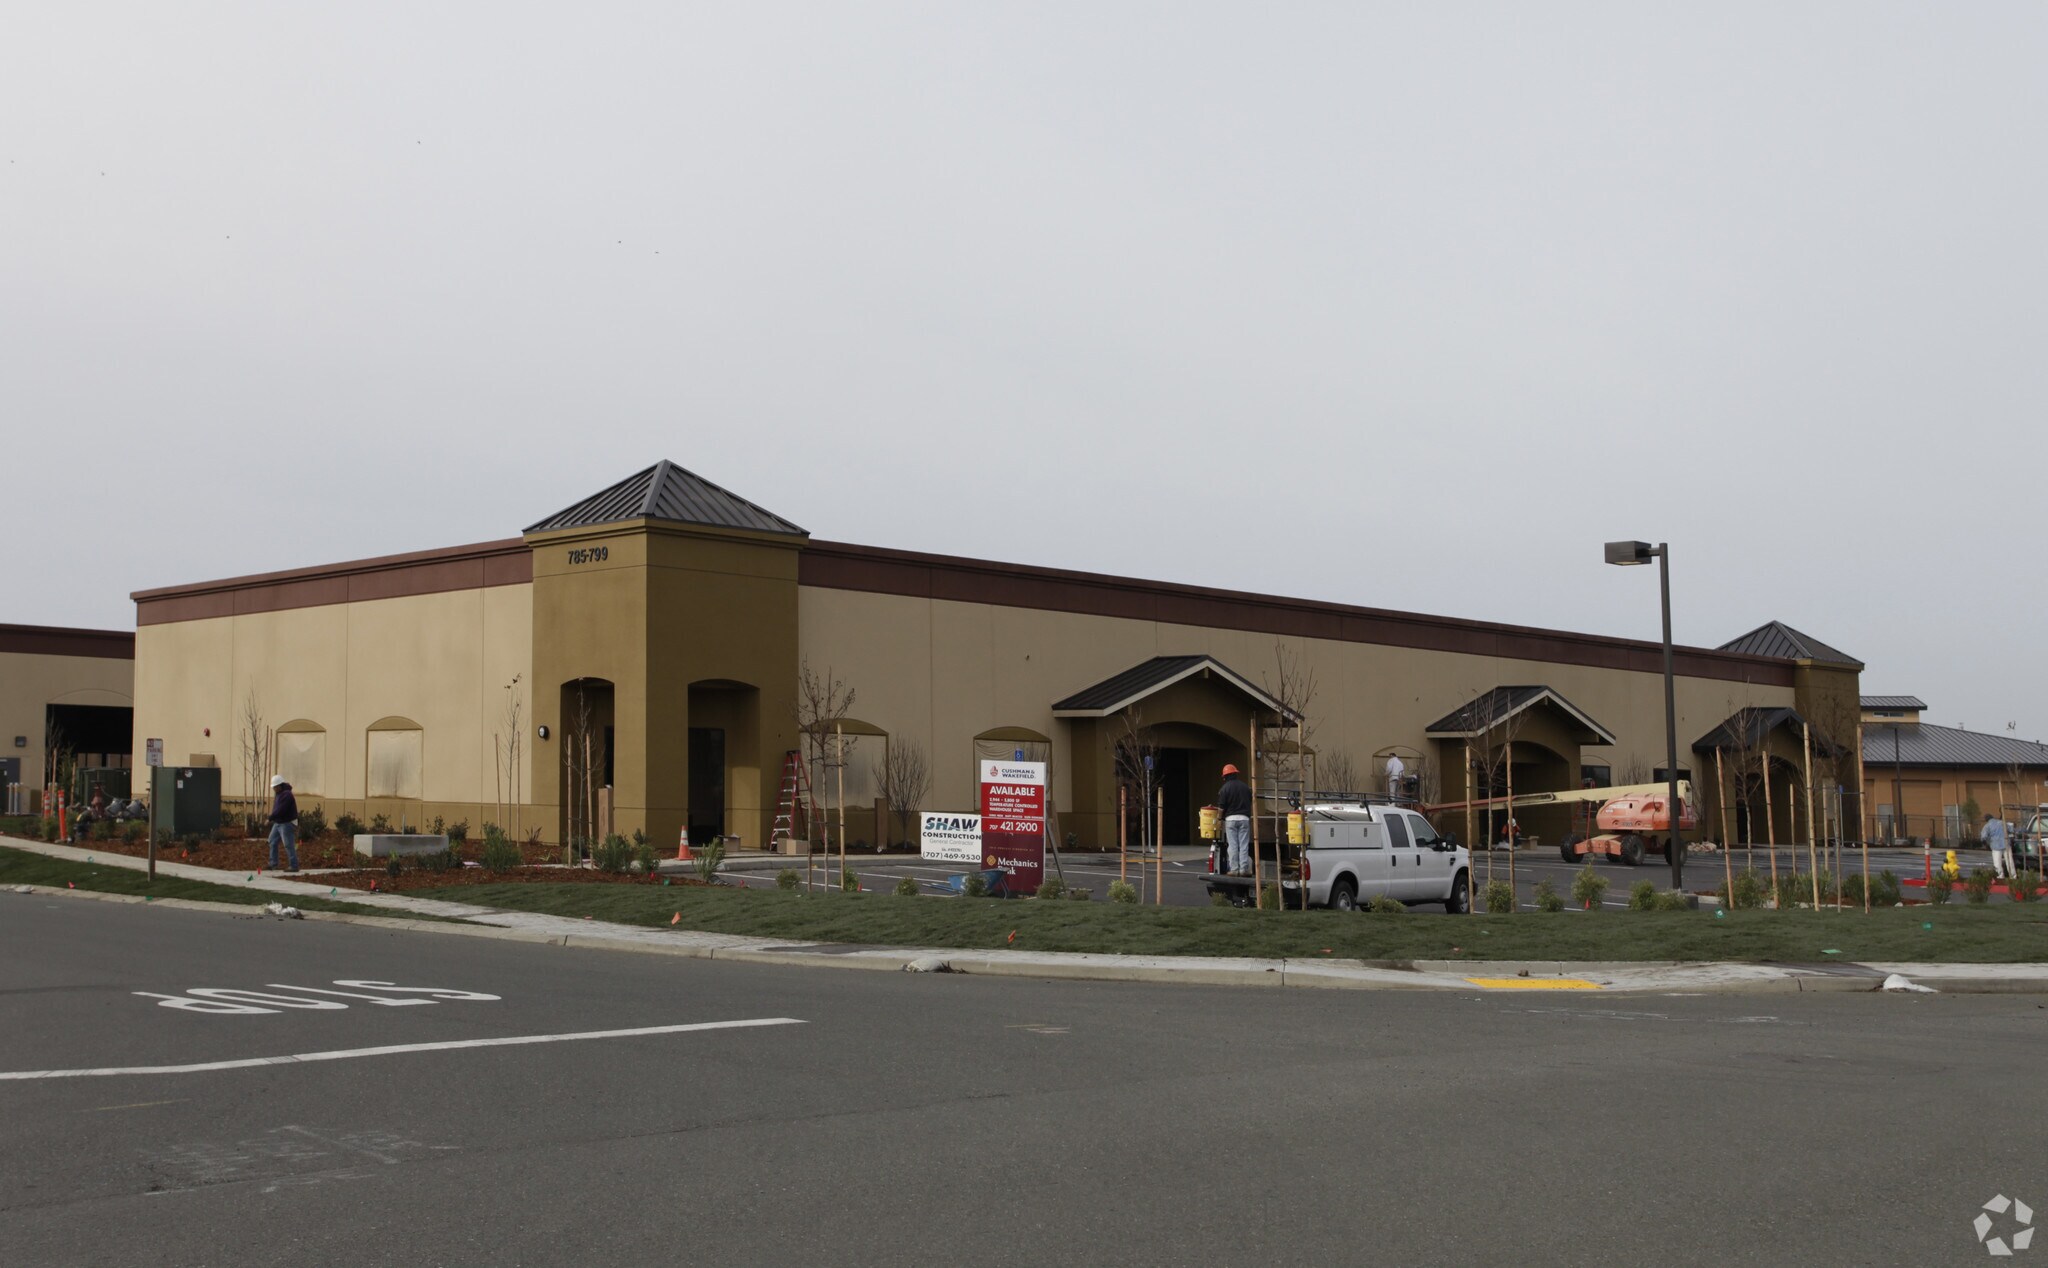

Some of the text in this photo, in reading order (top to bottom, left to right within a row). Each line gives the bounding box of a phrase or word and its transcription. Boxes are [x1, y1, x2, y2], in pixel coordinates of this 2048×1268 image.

[568, 546, 608, 565] 785-799
[989, 786, 1035, 796] AVAILABLE
[924, 816, 979, 832] SHAW
[1000, 821, 1014, 831] 421
[1015, 822, 1038, 832] 2900
[922, 831, 981, 840] CONSTRUCTION
[922, 851, 981, 861] (707) 469-9530
[997, 857, 1038, 868] Mechanics
[132, 979, 502, 1015] STOP
